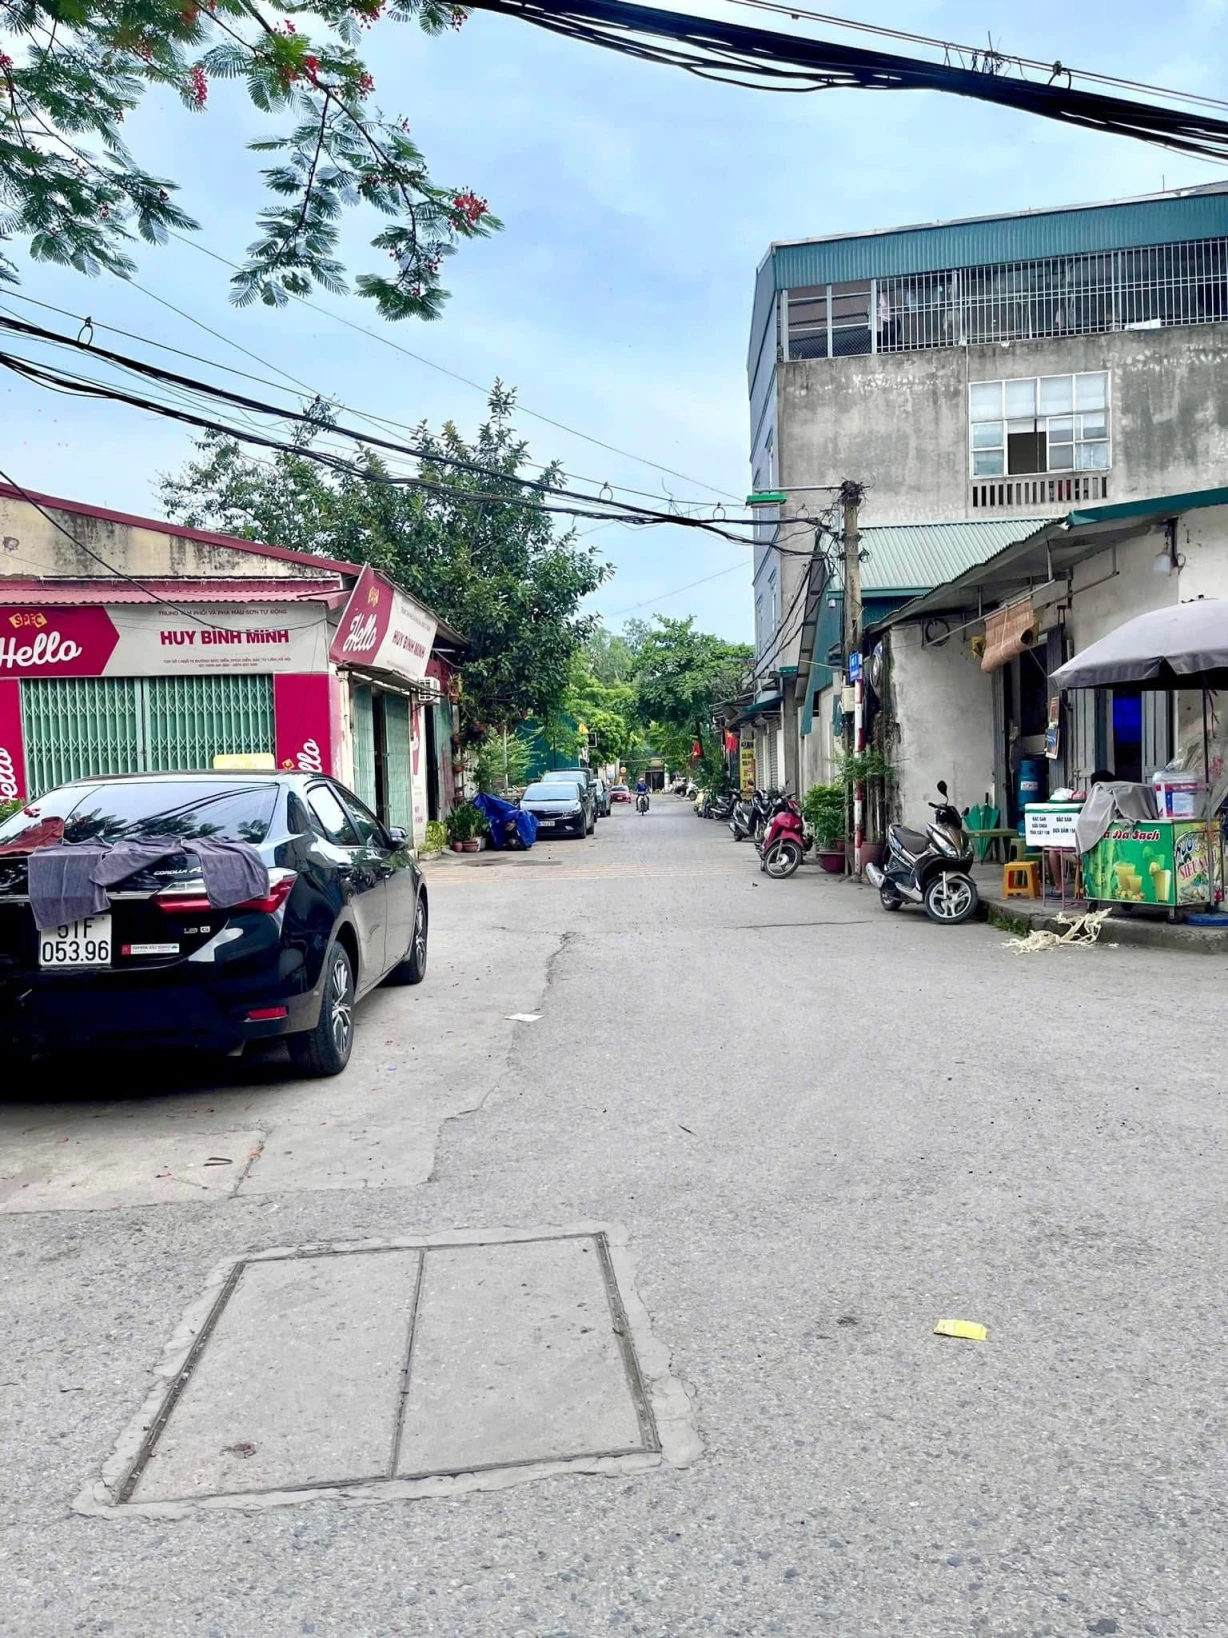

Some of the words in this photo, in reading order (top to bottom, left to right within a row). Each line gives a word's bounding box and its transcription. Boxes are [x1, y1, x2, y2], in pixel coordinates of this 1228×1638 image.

[160, 630, 196, 645] HUY
[201, 625, 242, 645] BÌNH
[246, 629, 290, 644] MINH
[0, 631, 82, 669] Hello
[57, 917, 95, 939] 51F
[42, 940, 109, 962] 053.96
